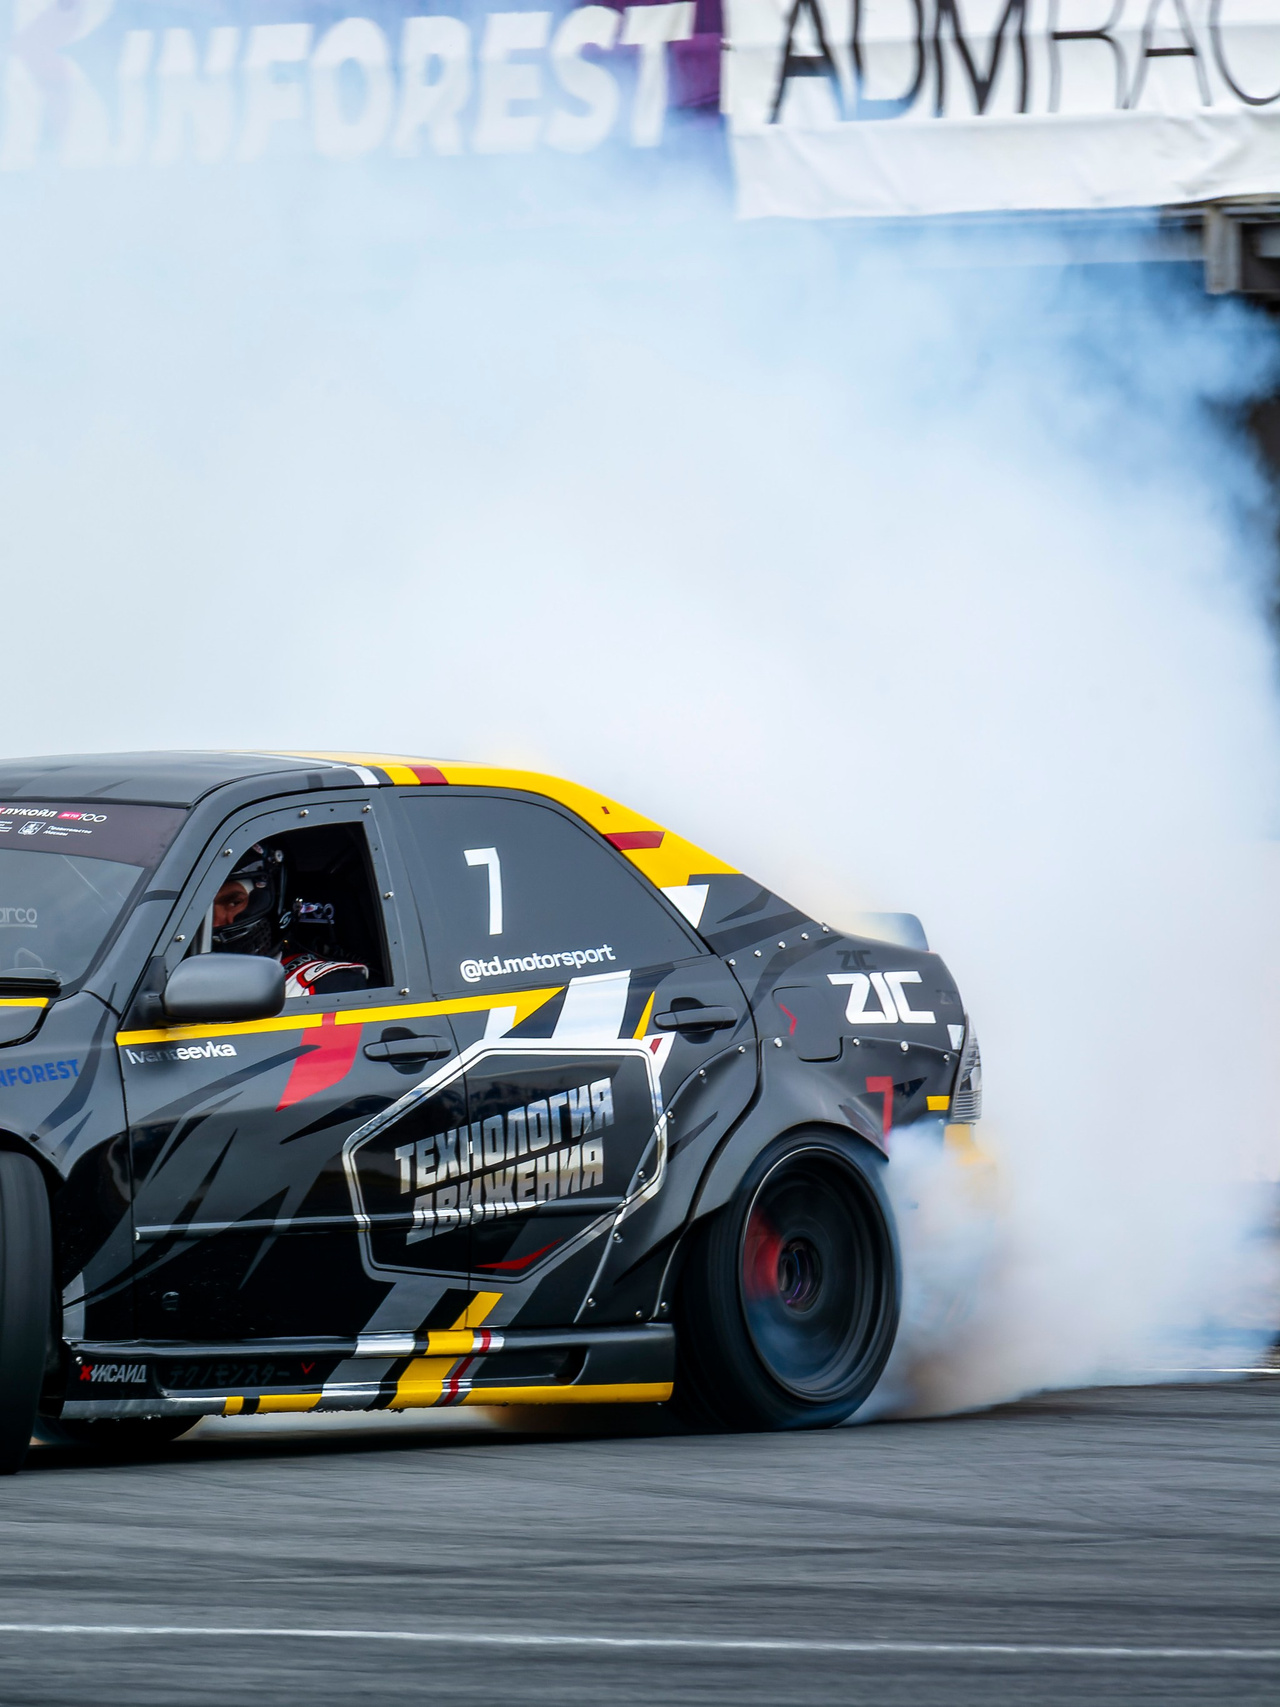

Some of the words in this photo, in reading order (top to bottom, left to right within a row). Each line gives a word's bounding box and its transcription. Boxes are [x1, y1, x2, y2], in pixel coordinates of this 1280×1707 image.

[2, 808, 58, 818] ЛУКОЙЛ
[459, 944, 617, 983] @td.motorsport
[826, 971, 937, 1024] ZIC
[394, 1076, 615, 1195] ТЕХНОЛОГИЯ
[405, 1136, 605, 1246] ДВИЖЕНИЯ
